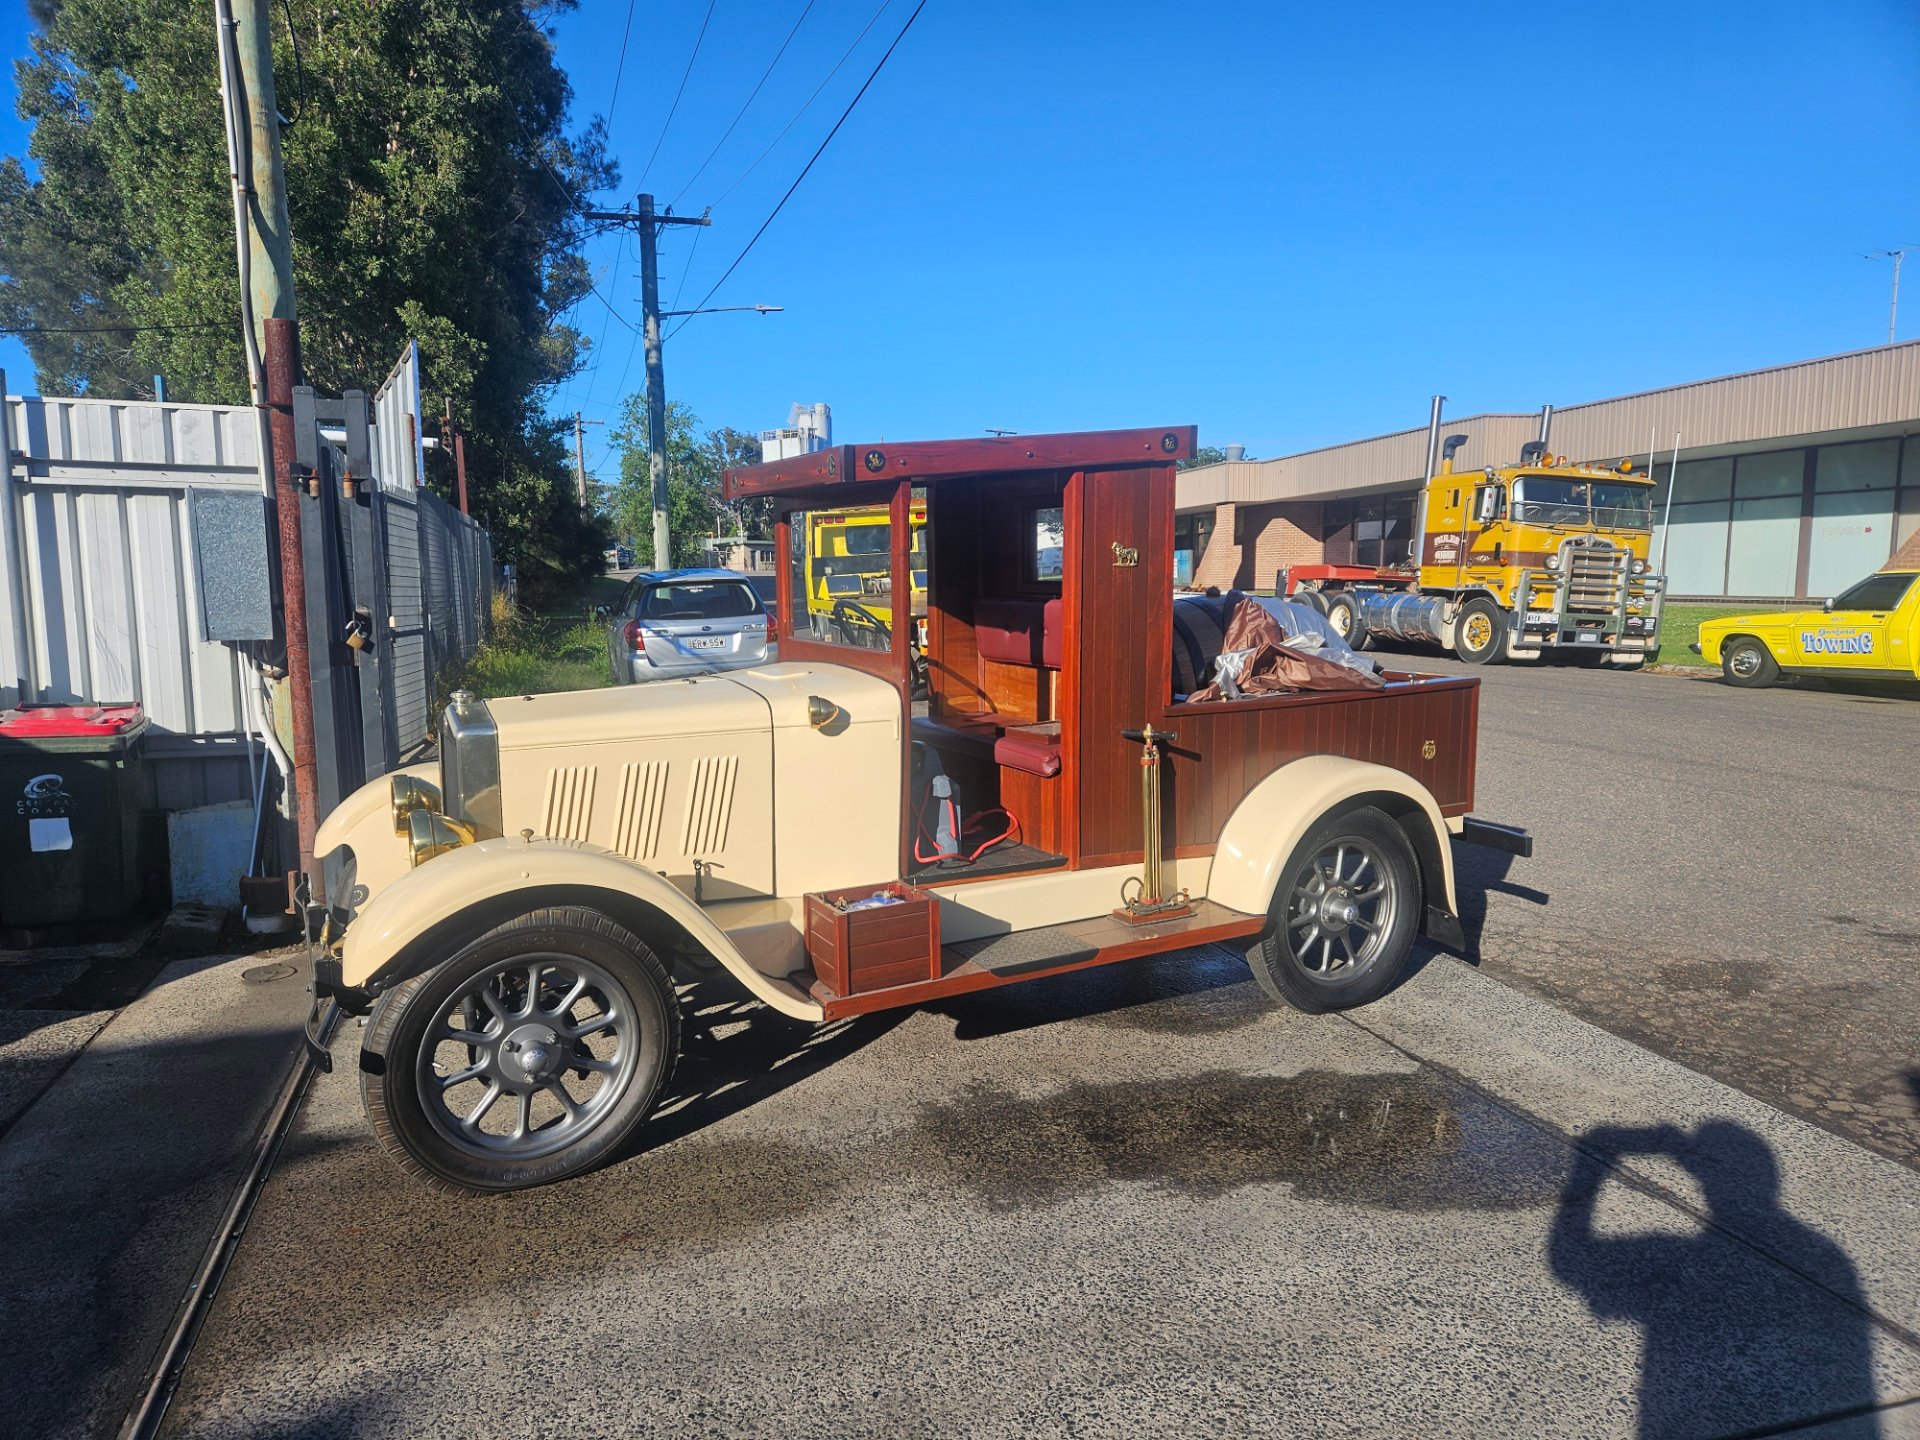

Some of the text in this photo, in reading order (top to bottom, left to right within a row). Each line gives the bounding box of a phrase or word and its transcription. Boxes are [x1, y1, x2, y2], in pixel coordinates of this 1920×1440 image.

[1801, 632, 1874, 654] TOWING
[16, 800, 80, 808] CENRA
[17, 807, 76, 815] COAS
